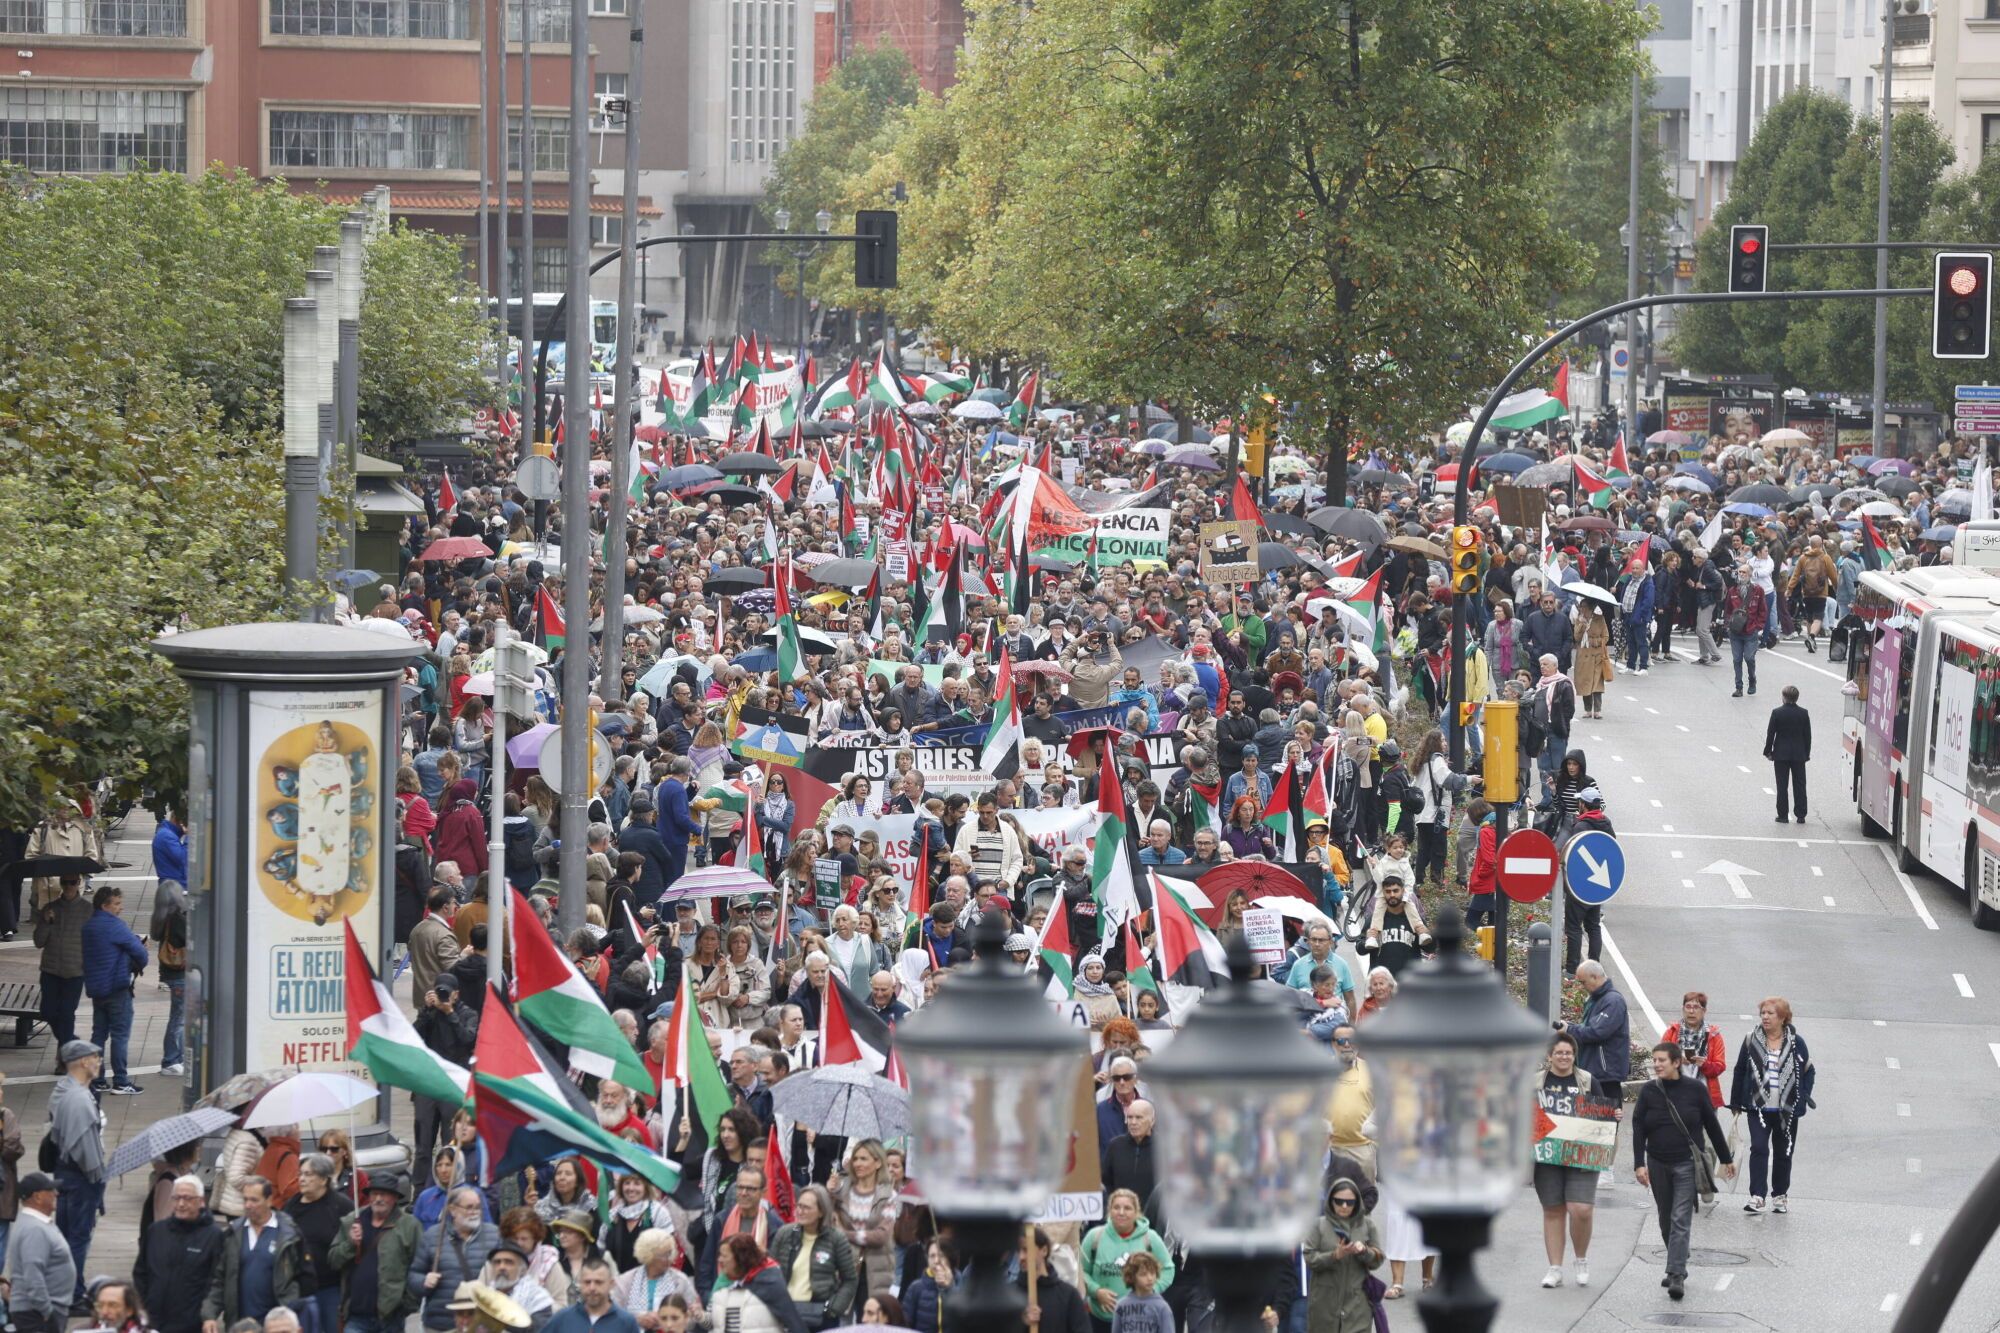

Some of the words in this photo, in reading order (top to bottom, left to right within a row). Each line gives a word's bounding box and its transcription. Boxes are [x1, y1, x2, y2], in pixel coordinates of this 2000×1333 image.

[1718, 406, 1765, 416] GUERLAIN
[276, 951, 296, 978] EL
[302, 1027, 330, 1036] SOLO
[332, 1026, 344, 1035] EN
[1538, 1089, 1554, 1109] NO
